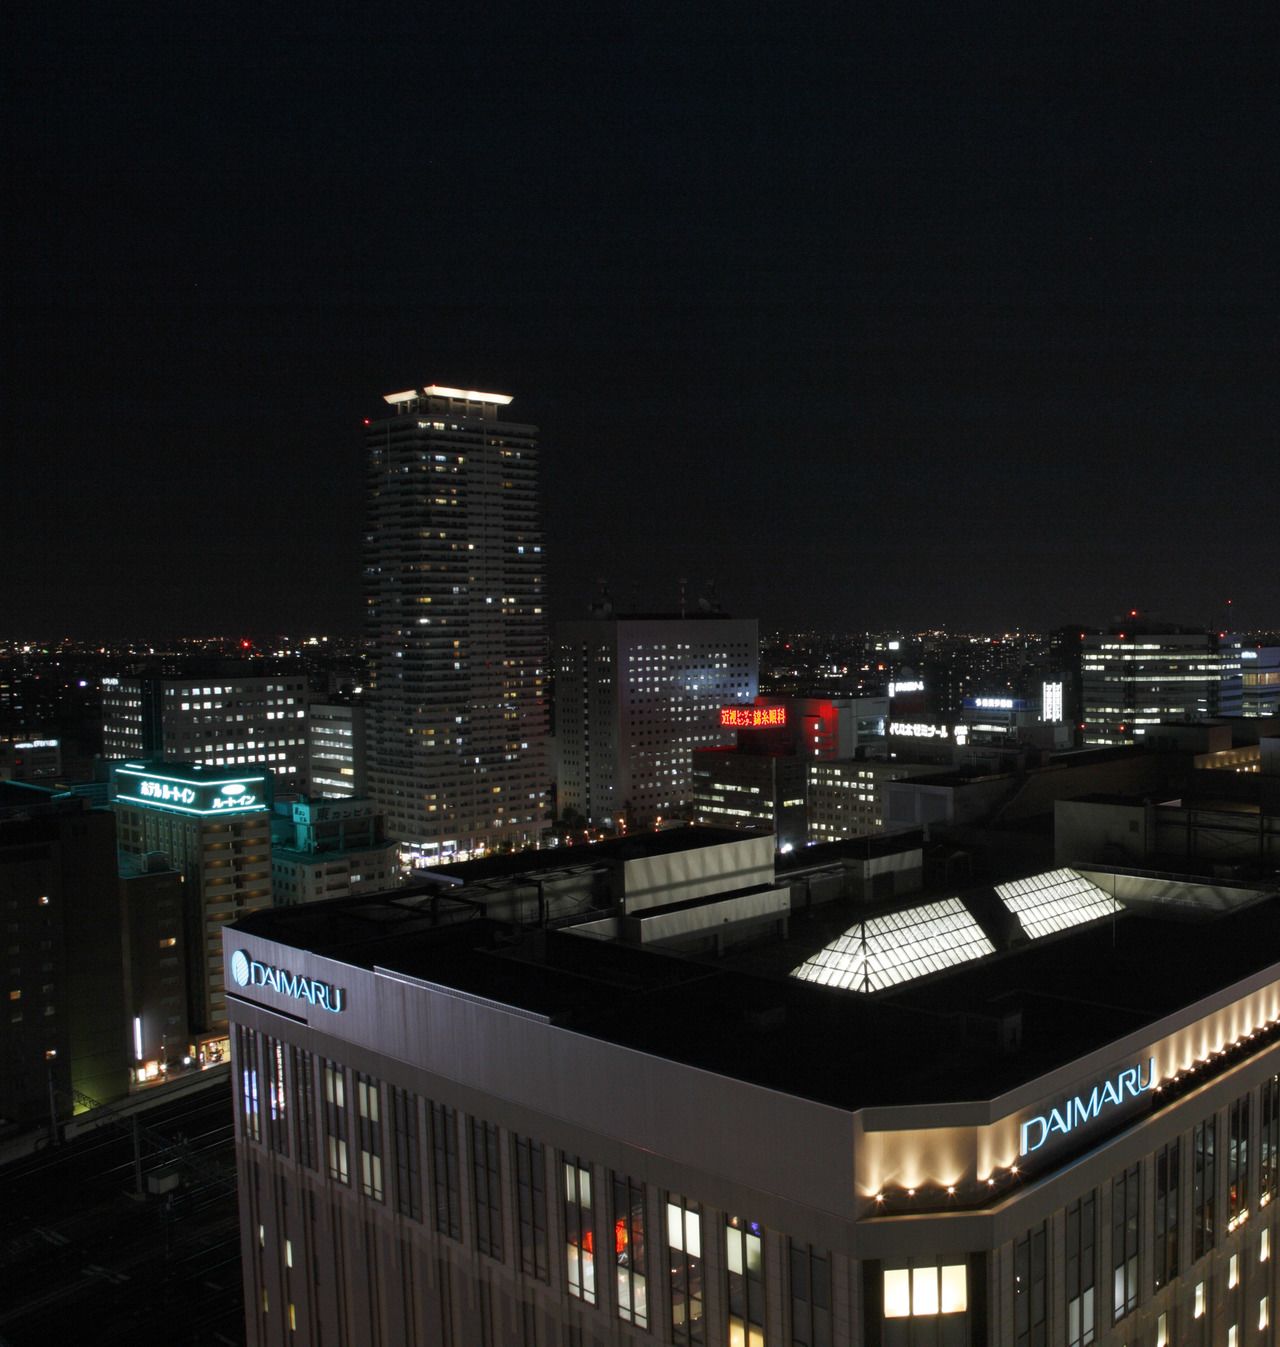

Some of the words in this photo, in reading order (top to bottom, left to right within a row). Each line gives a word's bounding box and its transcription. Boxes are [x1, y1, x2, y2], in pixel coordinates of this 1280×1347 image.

[889, 722, 948, 738] 代々木ゼミナール
[212, 795, 256, 809] ルートイン
[250, 961, 341, 1013] DAIMARU
[1020, 1057, 1155, 1157] DAIMARU
